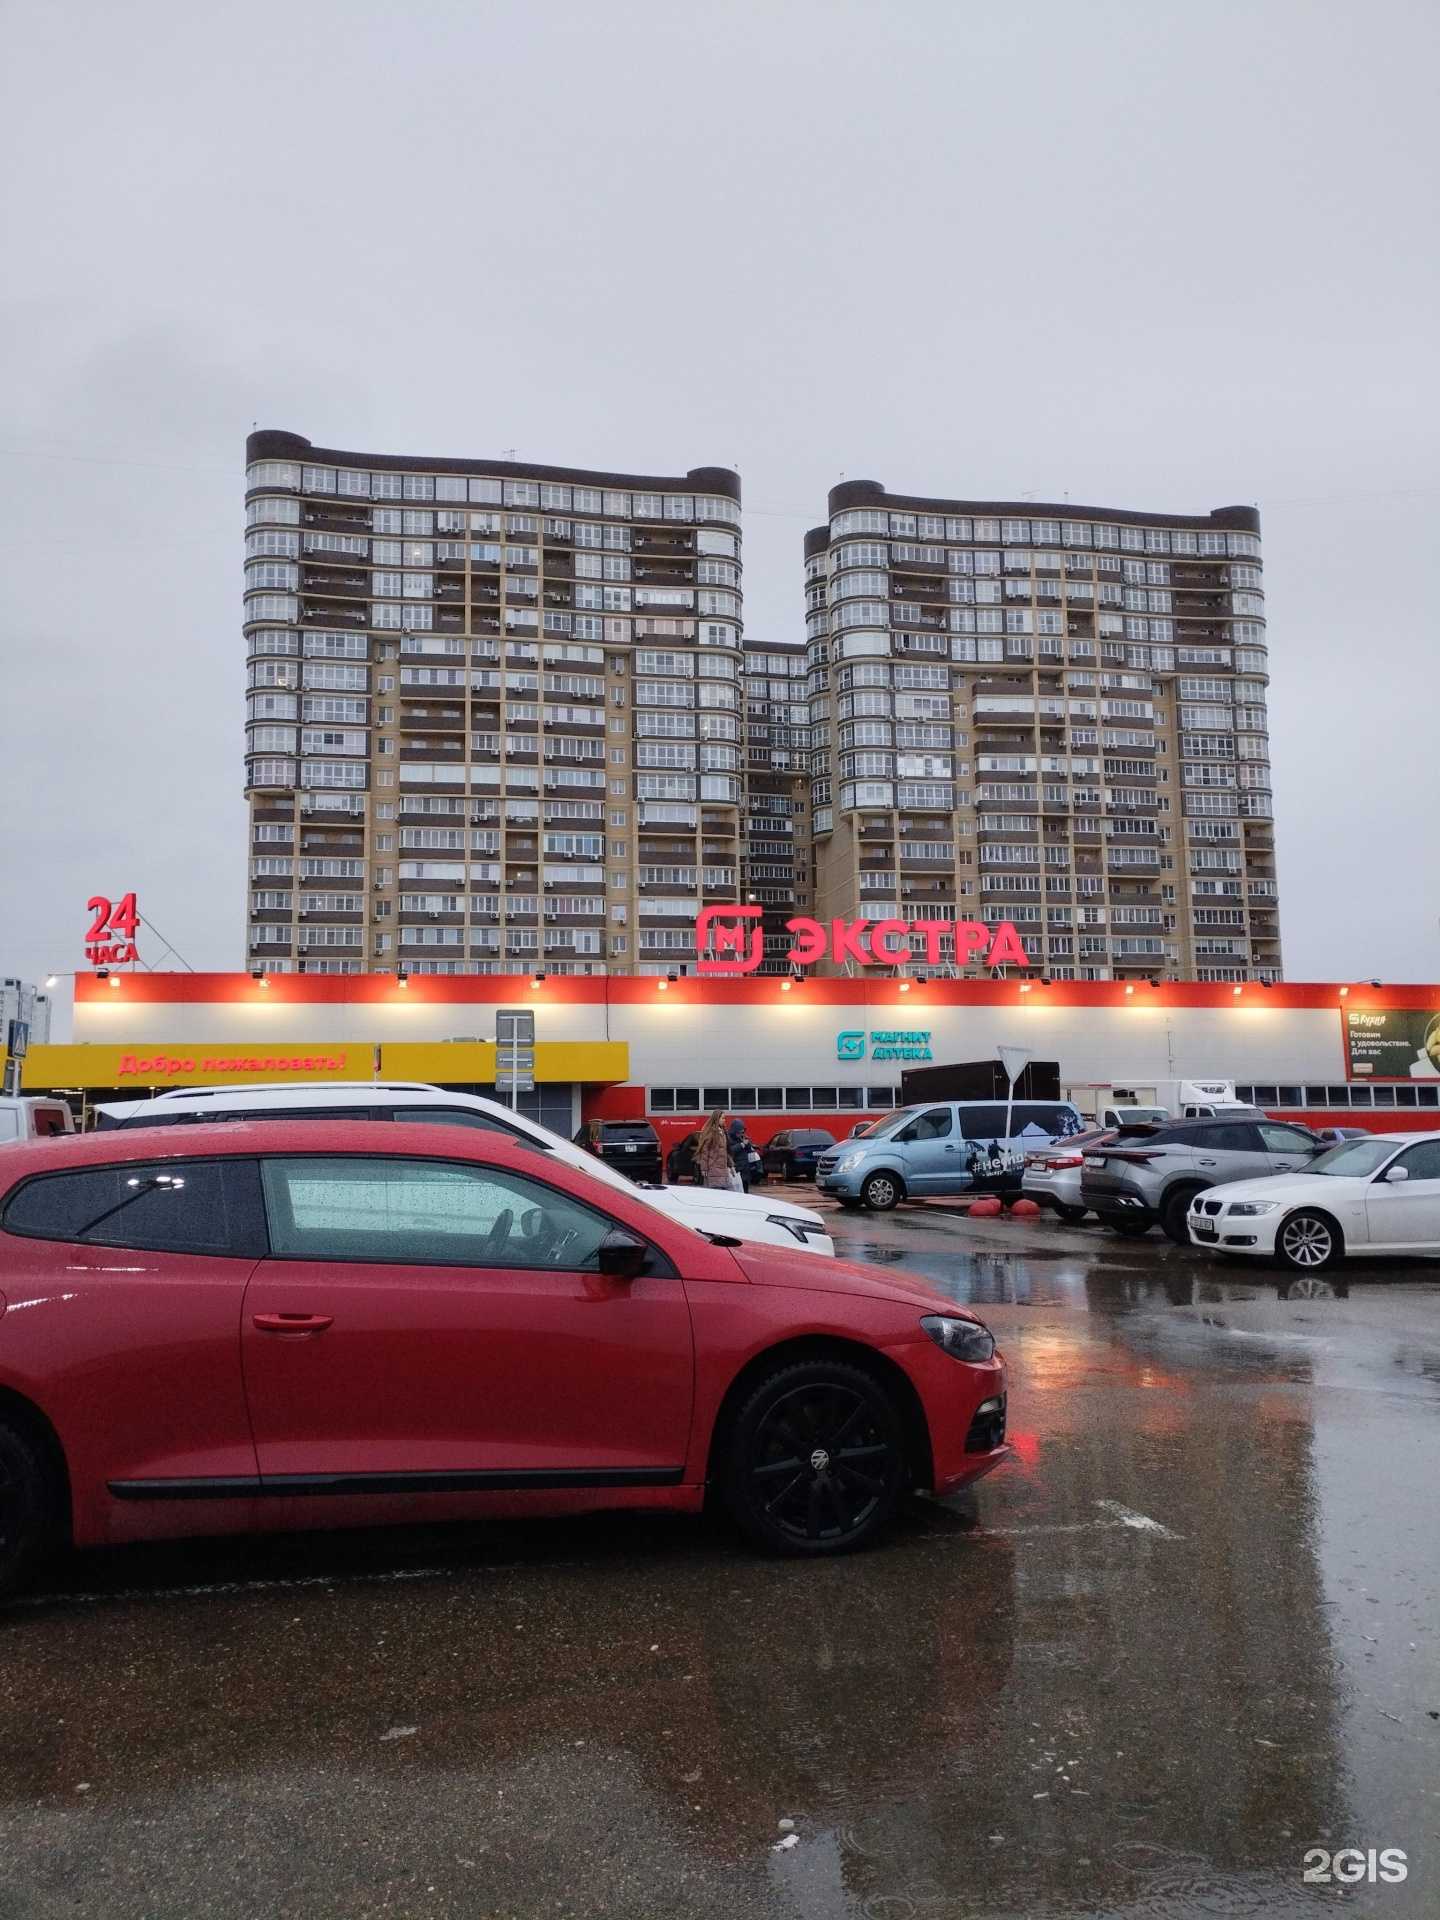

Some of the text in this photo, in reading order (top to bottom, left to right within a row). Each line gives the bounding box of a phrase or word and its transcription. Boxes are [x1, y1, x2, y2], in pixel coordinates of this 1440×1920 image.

[85, 893, 140, 943] 24
[786, 917, 1030, 967] ЭКСТРА
[85, 943, 140, 965] ЧАСА
[871, 1031, 931, 1043] МАГНИТ
[1350, 1031, 1381, 1039] Готовим
[872, 1047, 933, 1060] АПТЕКА
[1351, 1048, 1367, 1056] Для
[118, 1052, 347, 1077] Добро пожаловать!
